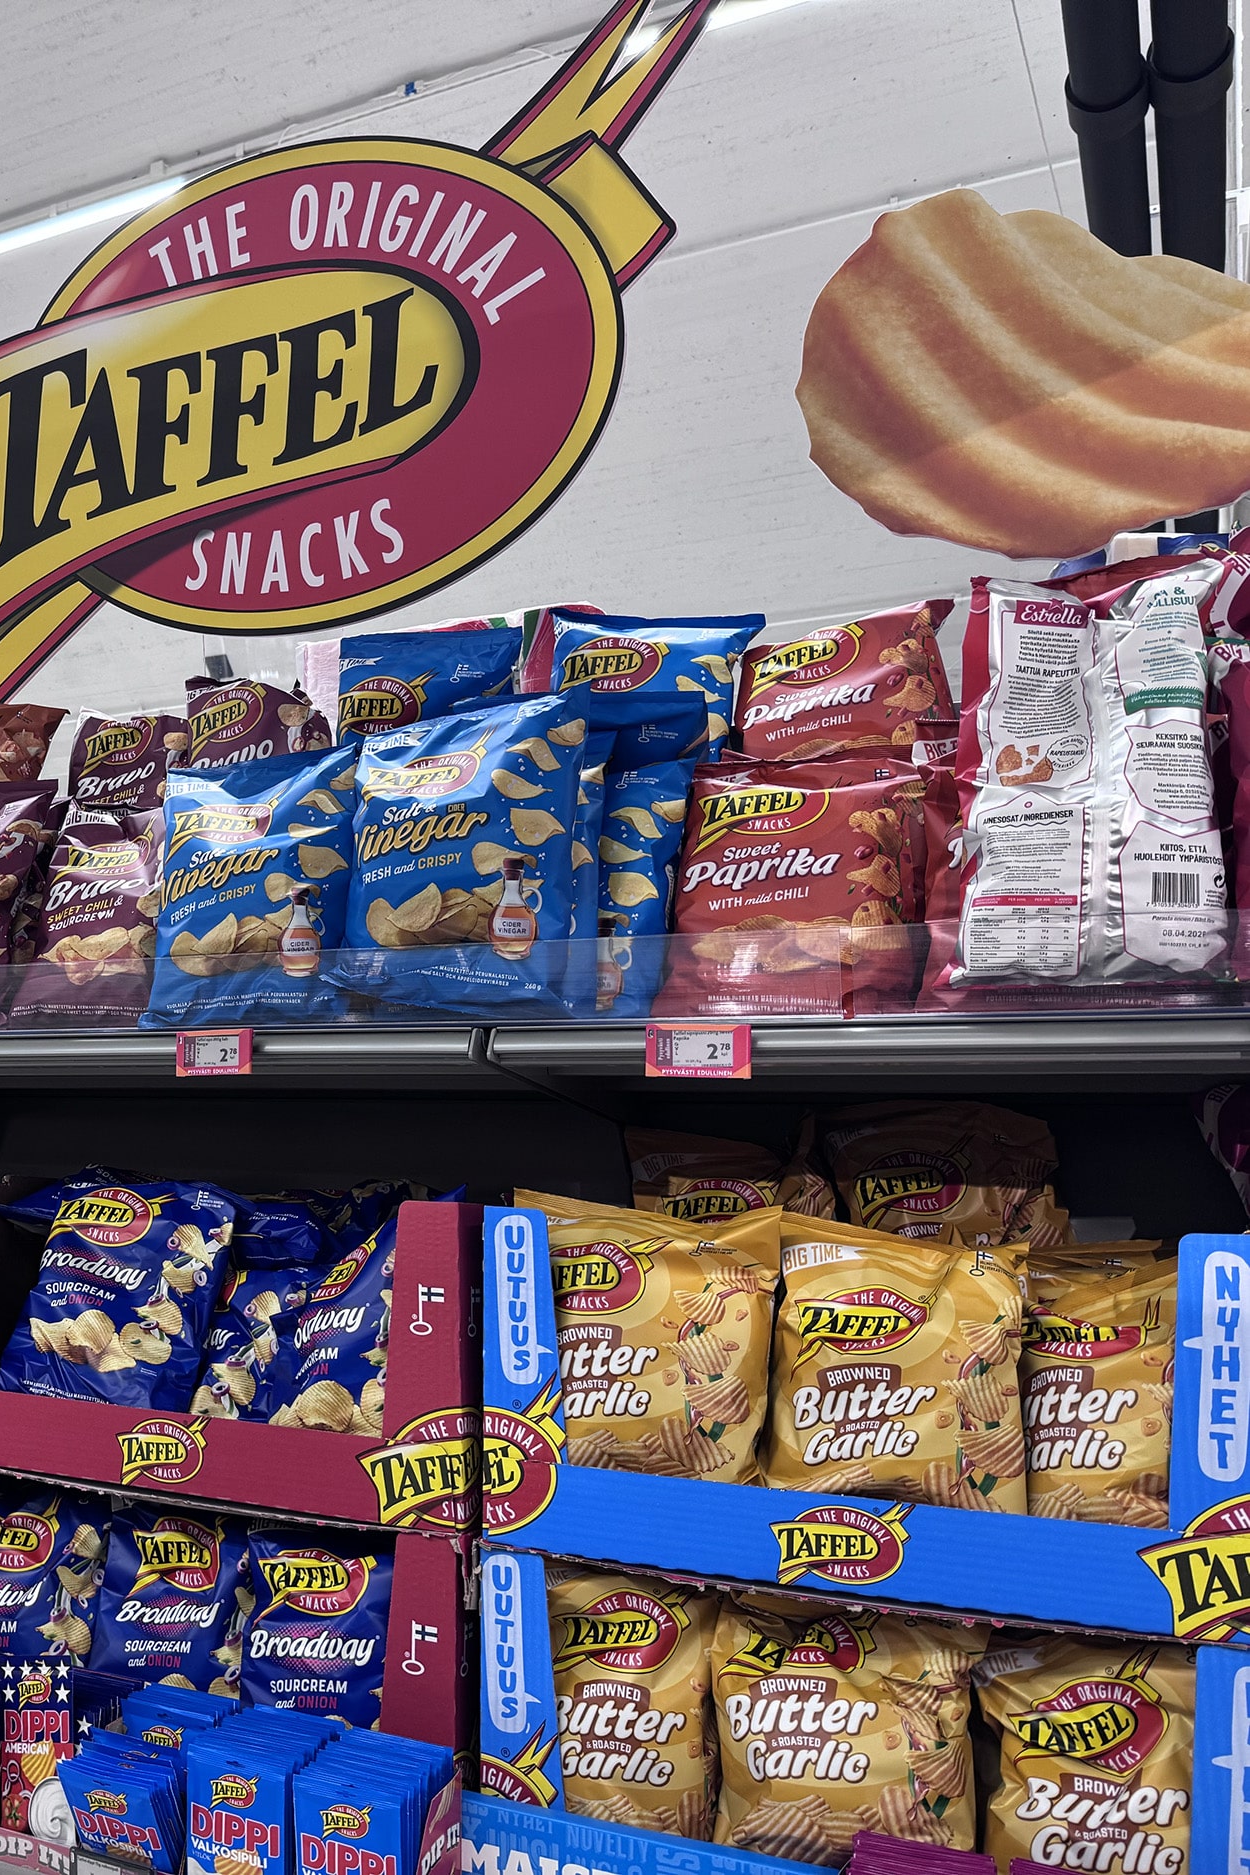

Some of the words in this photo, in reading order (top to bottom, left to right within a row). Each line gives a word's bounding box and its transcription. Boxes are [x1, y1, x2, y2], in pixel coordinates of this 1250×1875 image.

[149, 200, 250, 289] THE
[289, 180, 546, 326] ORIGINAL
[184, 498, 404, 595] SNACKS
[1021, 605, 1082, 625] Estrella
[1016, 665, 1040, 676] TAATTUA
[365, 681, 380, 690] THE
[382, 681, 410, 706] ORIGINAL
[597, 677, 636, 692] SNACKS
[743, 682, 874, 732] Paprika
[766, 728, 795, 743] WITH
[796, 720, 821, 735] mild
[821, 713, 852, 729] CHILI
[76, 761, 156, 800] Bravo
[166, 784, 184, 794] BIG
[187, 782, 212, 792] TIME
[382, 802, 423, 825] Salt
[448, 803, 465, 813] CIDER
[355, 811, 488, 867] Vinegar
[723, 841, 781, 861] Sweet
[1160, 844, 1183, 853] KIITOS,
[1189, 844, 1207, 853] ETTÄ
[362, 866, 391, 886] FRESH
[394, 861, 415, 874] and
[418, 852, 462, 870] CRISPY
[1134, 852, 1175, 862] HUOLEHDIT
[161, 848, 279, 911] Vinegar
[682, 850, 841, 894] Paprika
[47, 902, 82, 924] SWEET
[84, 898, 114, 914] CHILI
[114, 896, 123, 906] &
[170, 902, 196, 924] FRESH
[198, 895, 216, 909] and
[218, 884, 256, 902] CRISPY
[708, 896, 744, 911] WITH
[745, 890, 773, 907] mild
[774, 886, 809, 903] CHILI
[220, 1049, 228, 1062] 2
[707, 1044, 718, 1059] 2
[87, 1227, 121, 1241] SNACKS
[783, 1248, 808, 1271] BIG
[809, 1245, 845, 1265] TIME
[45, 1281, 116, 1302] SOURCREAM
[51, 1295, 68, 1308] and
[69, 1293, 104, 1307] ONION
[504, 1224, 530, 1372] UUTUUS
[827, 1369, 892, 1387] BROWNED
[1030, 1369, 1083, 1391] BROWNED
[1209, 1265, 1241, 1470] NYHET
[793, 1381, 938, 1431] Butter
[802, 1424, 919, 1468] Garlic
[1041, 1426, 1078, 1441] ROASTED
[122, 1439, 186, 1463] TAFFEL
[153, 1466, 182, 1479] SNACKS
[778, 1530, 876, 1562] TAFFEL
[827, 1564, 871, 1579] SNACKS
[115, 1599, 221, 1628] Broadway
[564, 1619, 658, 1648] TAFFEL
[124, 1639, 191, 1655] SOURCREAM
[250, 1629, 376, 1667] Broadway
[269, 1678, 348, 1695] SOURCREAM
[582, 1684, 641, 1702] BROWNED
[276, 1696, 295, 1710] and
[297, 1696, 338, 1709] ONION
[4, 1710, 70, 1743] DIPPI
[726, 1694, 878, 1743] Butter
[1019, 1705, 1130, 1752] TAFFEL
[5, 1743, 50, 1754] AMERICAN
[780, 1736, 821, 1749] ROASTED
[748, 1740, 869, 1782] Garlic
[1015, 1777, 1189, 1829] Butter
[73, 1807, 162, 1851] DIPPI
[191, 1801, 280, 1858] DIPPI
[191, 1836, 268, 1869] VALKOSIPULI
